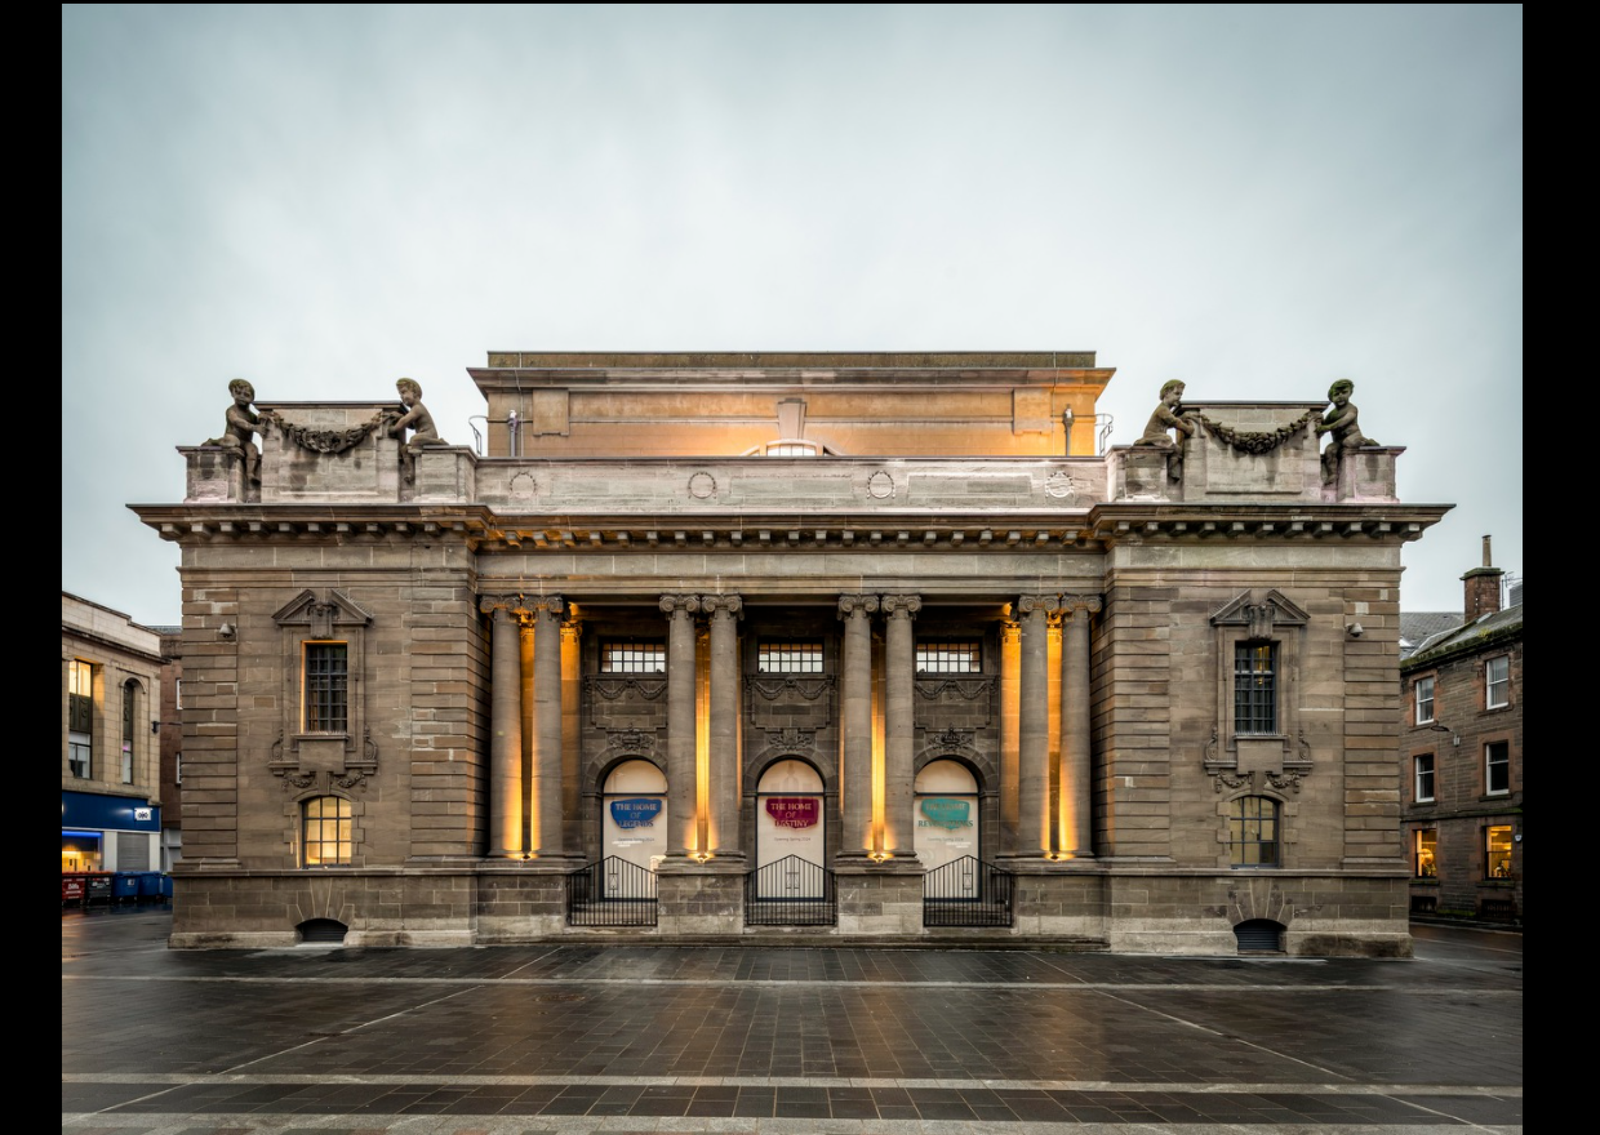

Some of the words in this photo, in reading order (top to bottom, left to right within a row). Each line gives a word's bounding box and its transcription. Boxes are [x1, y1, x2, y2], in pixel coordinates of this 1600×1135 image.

[615, 803, 631, 811] THE
[633, 803, 657, 811] HOME
[770, 803, 786, 811] THE
[788, 803, 812, 811] HOME
[942, 803, 966, 811] HOME
[630, 811, 641, 819] OF
[785, 811, 796, 819] OF
